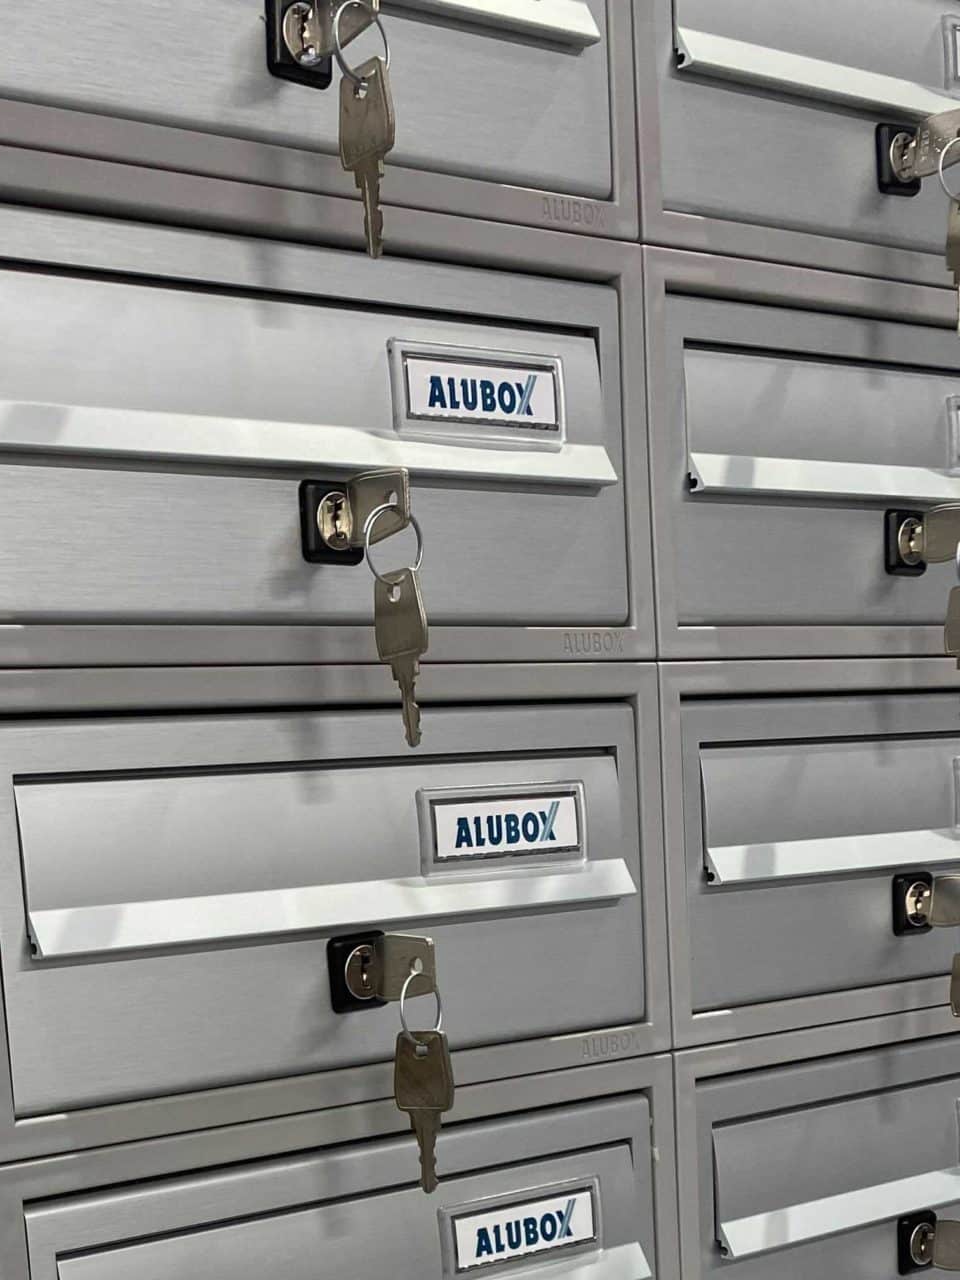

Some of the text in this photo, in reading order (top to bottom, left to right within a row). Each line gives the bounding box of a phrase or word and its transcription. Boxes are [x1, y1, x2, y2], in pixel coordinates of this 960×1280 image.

[541, 197, 606, 227] ALUBOX
[428, 375, 537, 415] ALUBOX
[563, 631, 625, 653] ALUBOX
[455, 801, 560, 848] ALUBOX
[476, 1199, 576, 1257] ALUBOX
